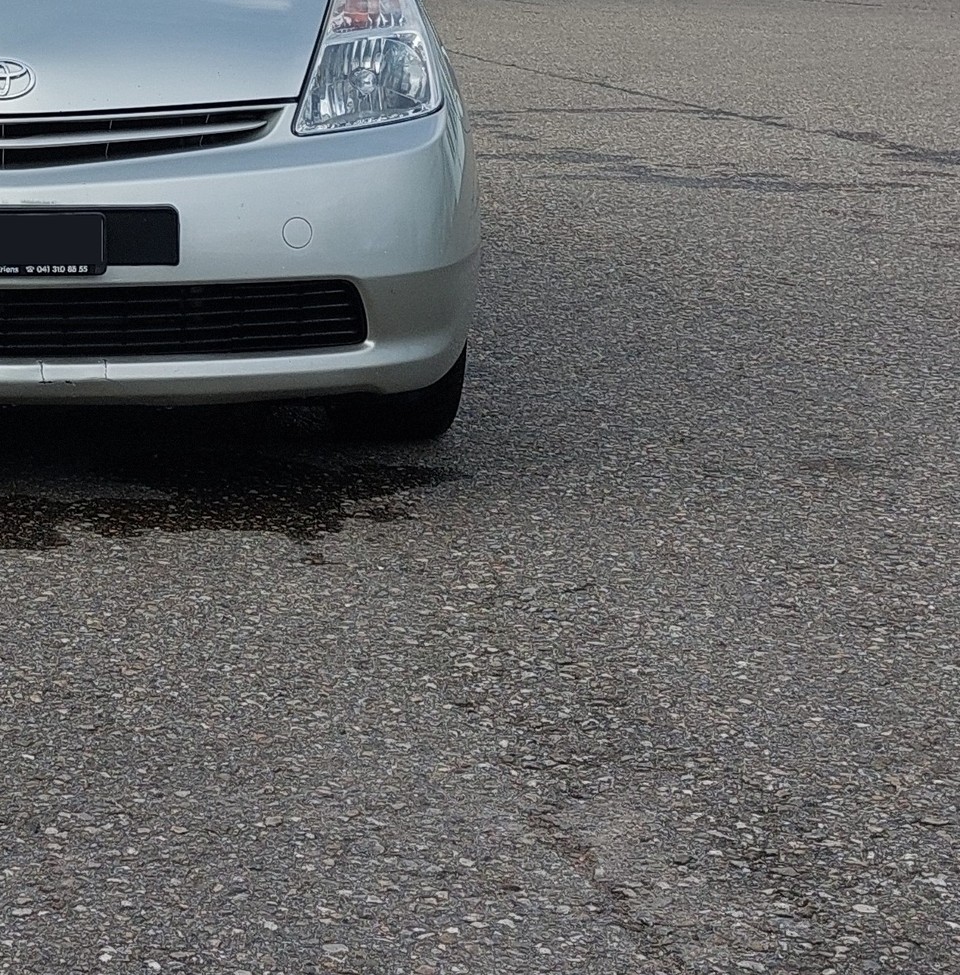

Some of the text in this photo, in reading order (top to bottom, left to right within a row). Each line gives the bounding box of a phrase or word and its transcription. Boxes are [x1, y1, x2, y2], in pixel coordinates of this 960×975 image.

[36, 265, 51, 273] 041
[51, 265, 66, 273] 310
[78, 265, 88, 273] 55
